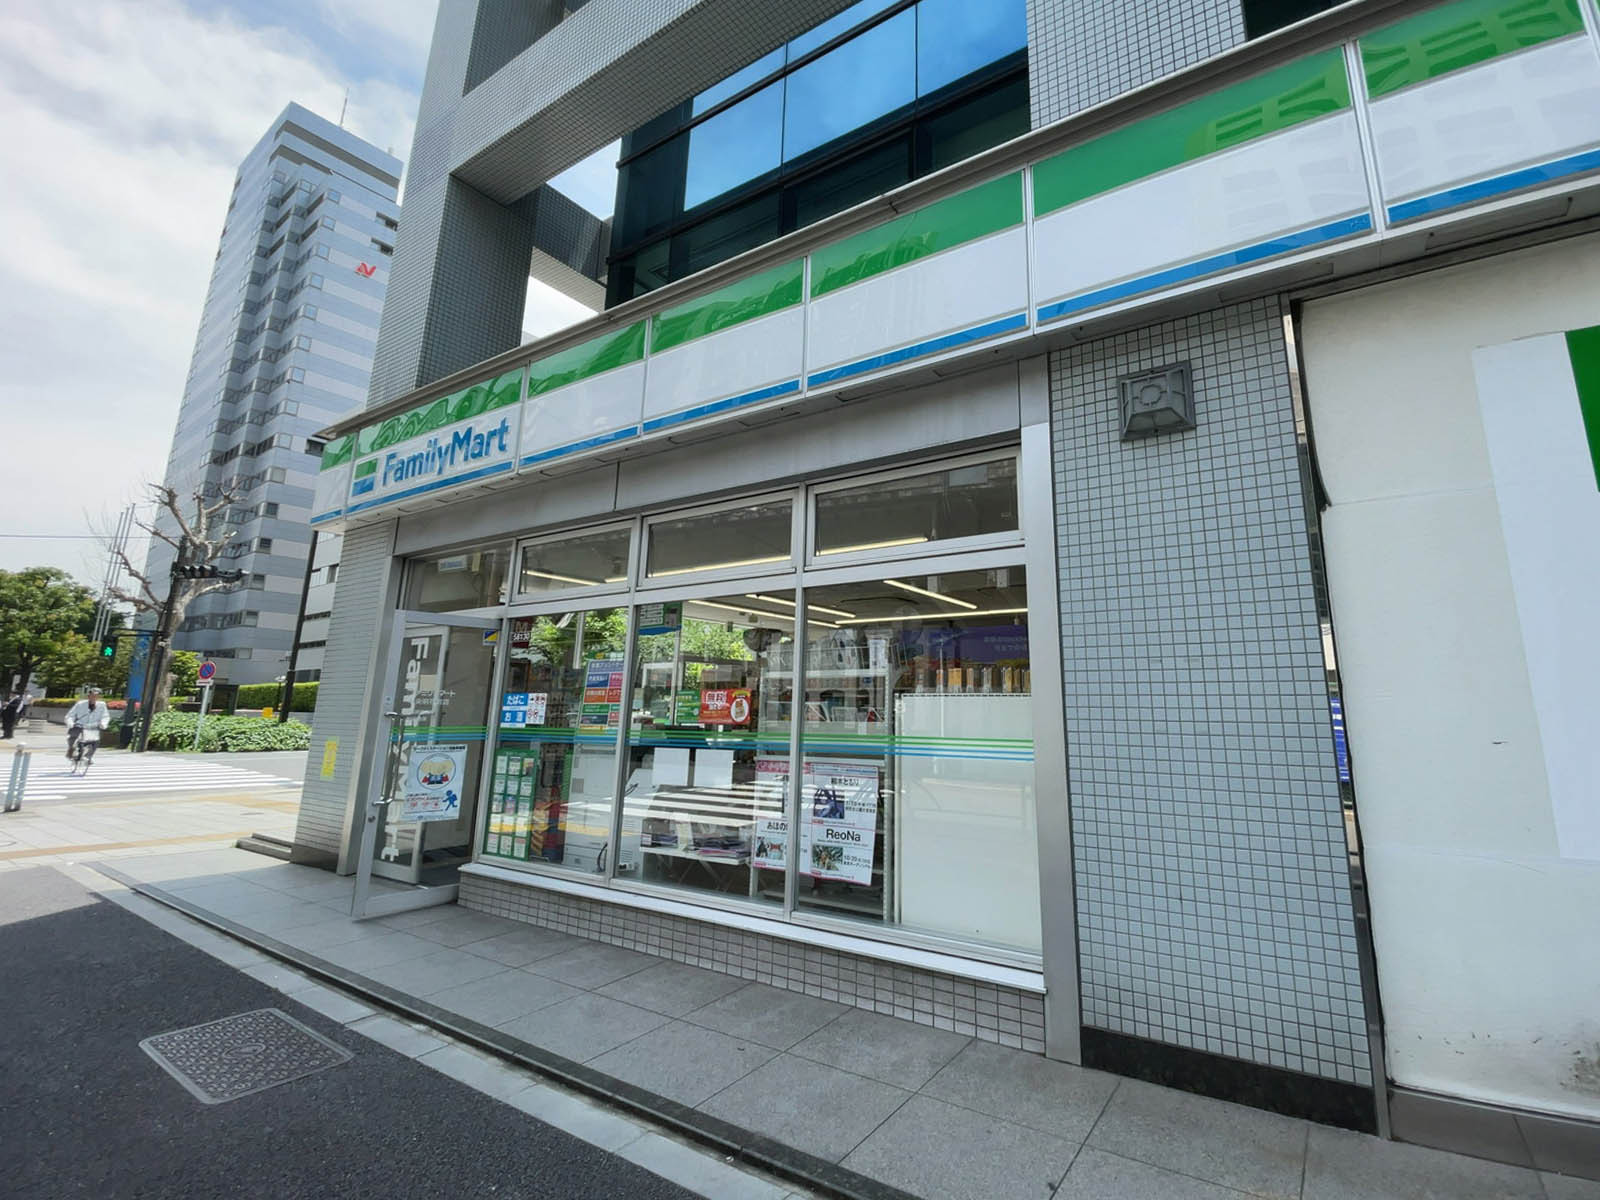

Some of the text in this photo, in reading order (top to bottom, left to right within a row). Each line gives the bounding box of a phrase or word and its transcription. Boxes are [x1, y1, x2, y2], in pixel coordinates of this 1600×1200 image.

[381, 417, 510, 487] FamilyMart
[381, 637, 429, 862] FamiyMart
[825, 828, 861, 842] ReoNa
